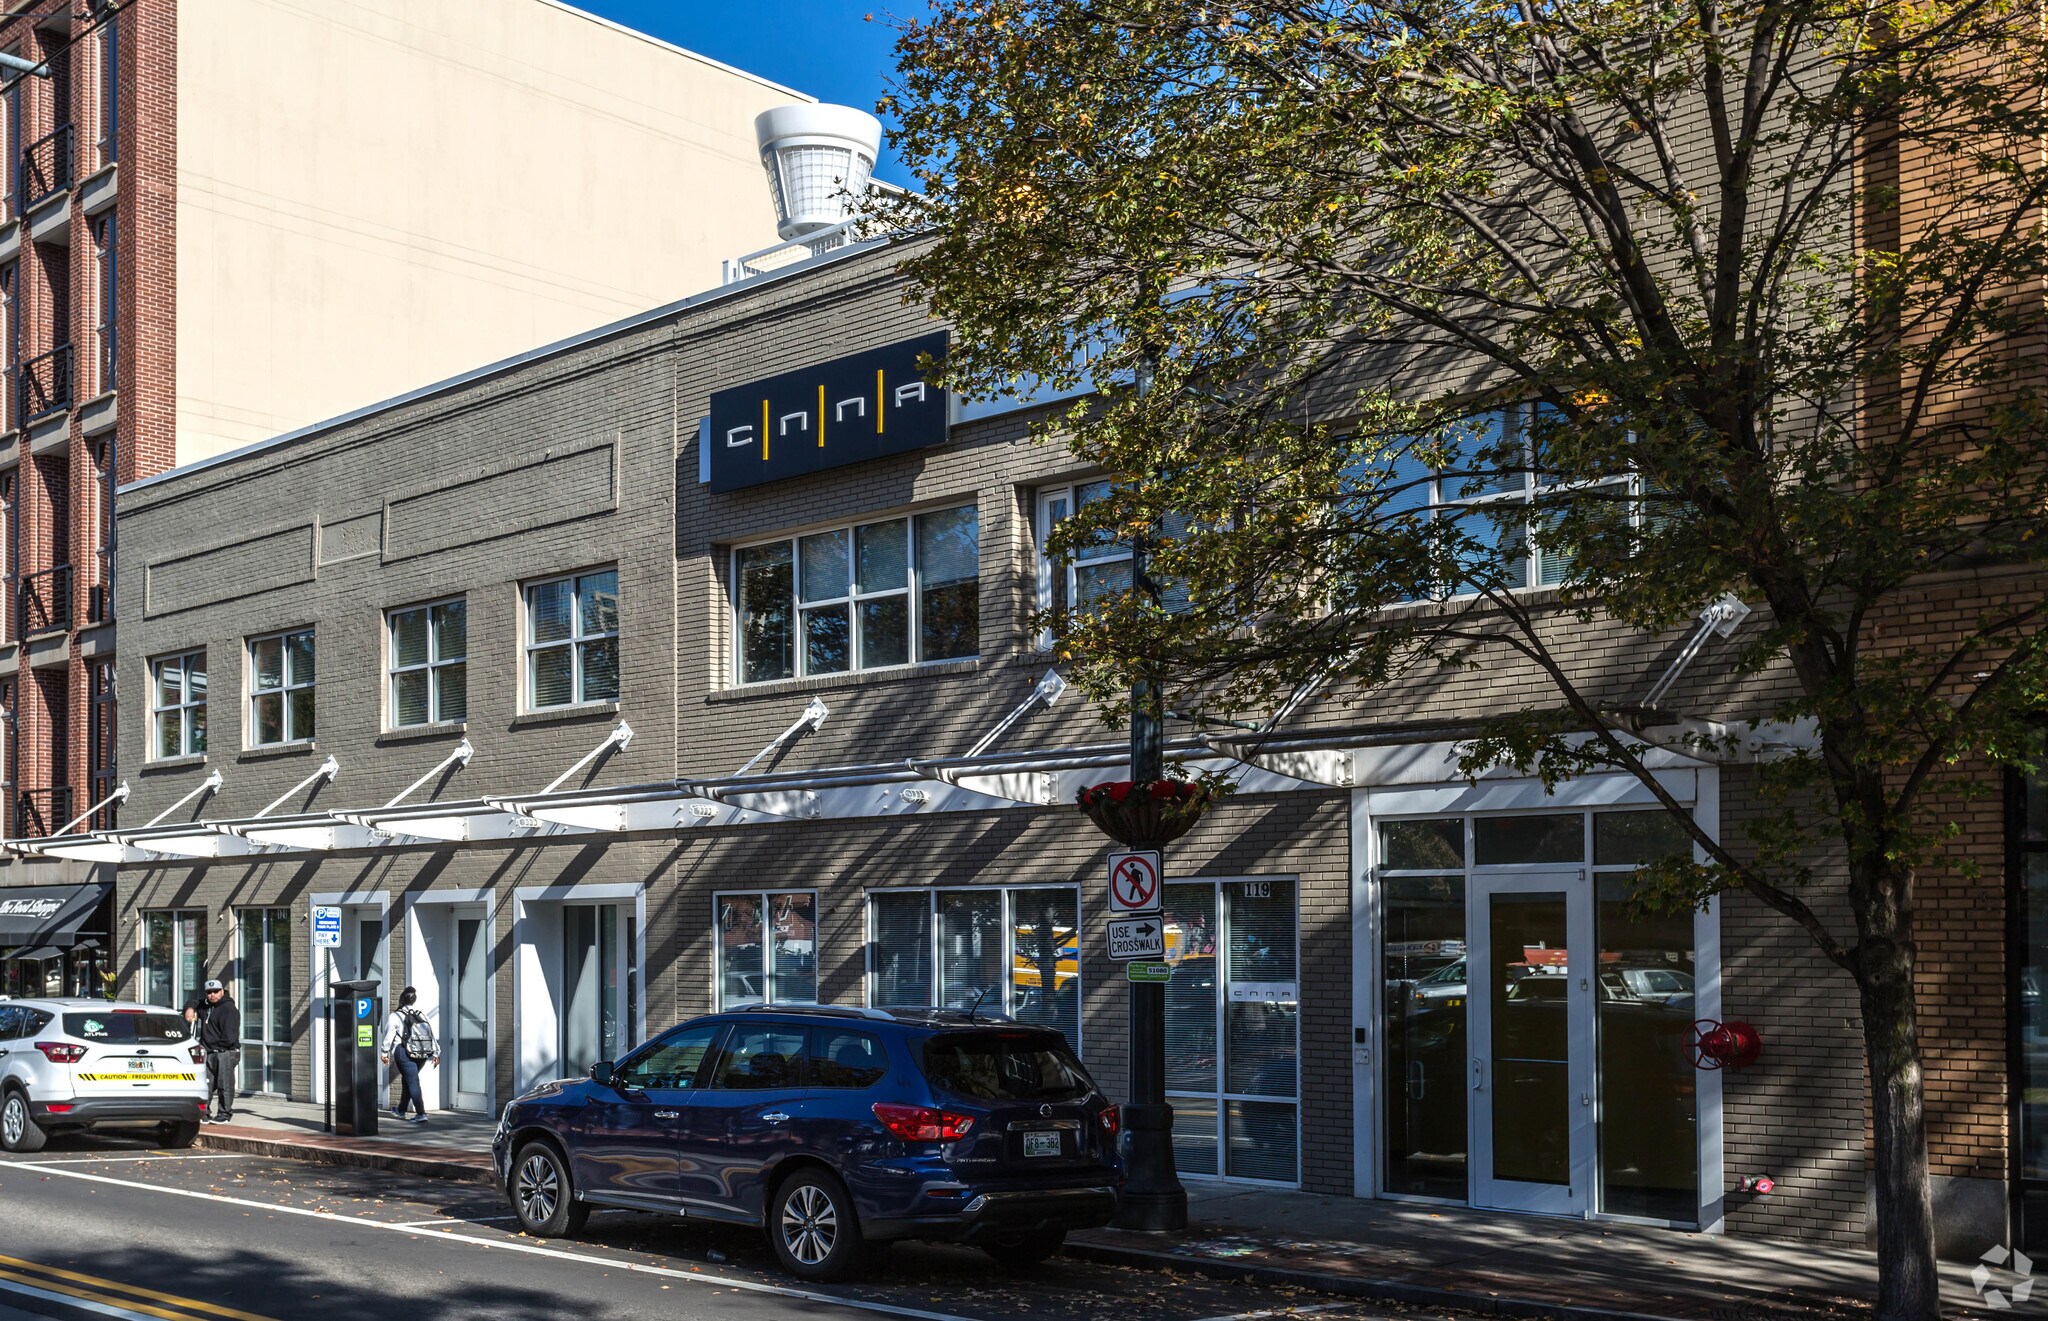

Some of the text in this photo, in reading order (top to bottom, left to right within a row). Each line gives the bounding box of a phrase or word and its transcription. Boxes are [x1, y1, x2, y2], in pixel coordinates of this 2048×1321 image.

[1245, 883, 1270, 897] 119
[10, 900, 35, 914] Food
[28, 899, 60, 916] Shoppe
[1112, 926, 1130, 939] USE
[1112, 937, 1161, 953] CROSSWALK
[358, 1000, 368, 1015] P
